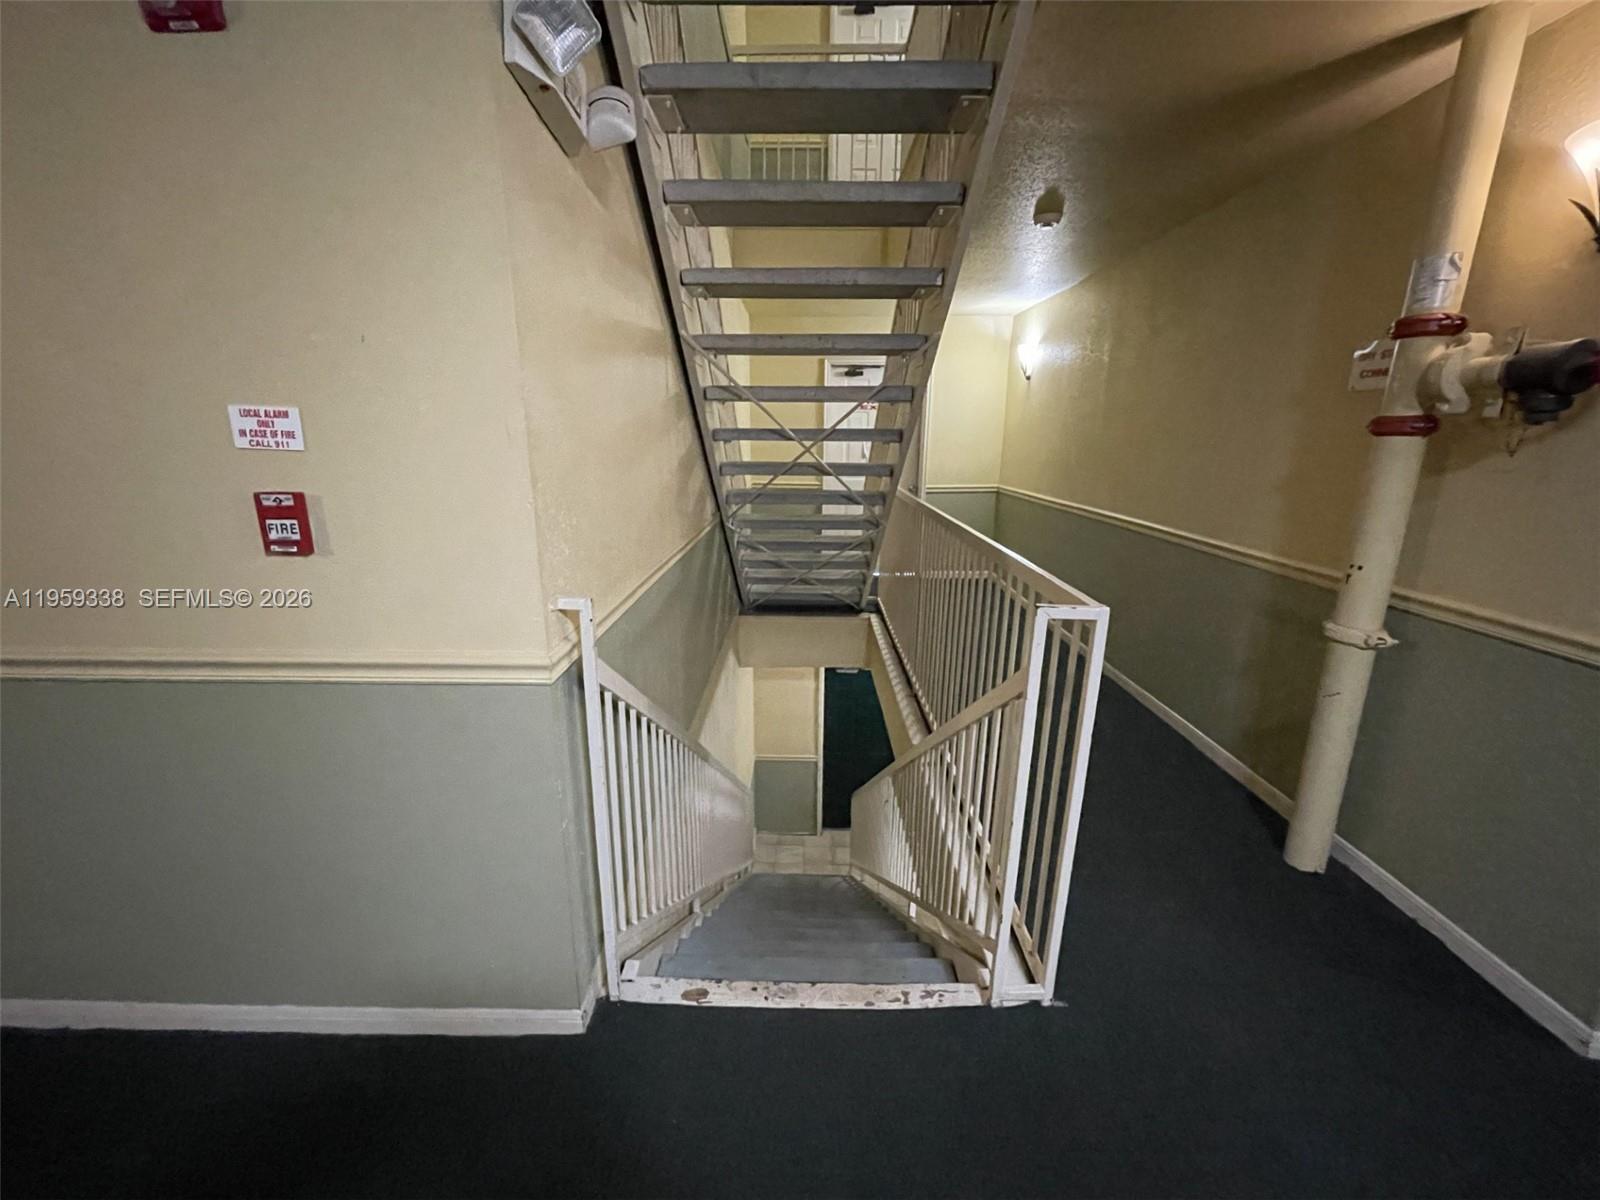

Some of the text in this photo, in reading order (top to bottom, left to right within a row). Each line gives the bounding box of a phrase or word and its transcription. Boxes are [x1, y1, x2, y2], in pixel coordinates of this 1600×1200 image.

[238, 408, 289, 419] LOCAL ALARM
[256, 419, 275, 429] ONLY
[238, 428, 297, 440] IN CASE OF FIRE
[248, 439, 291, 449] CALL 911
[267, 522, 299, 535] FIRE
